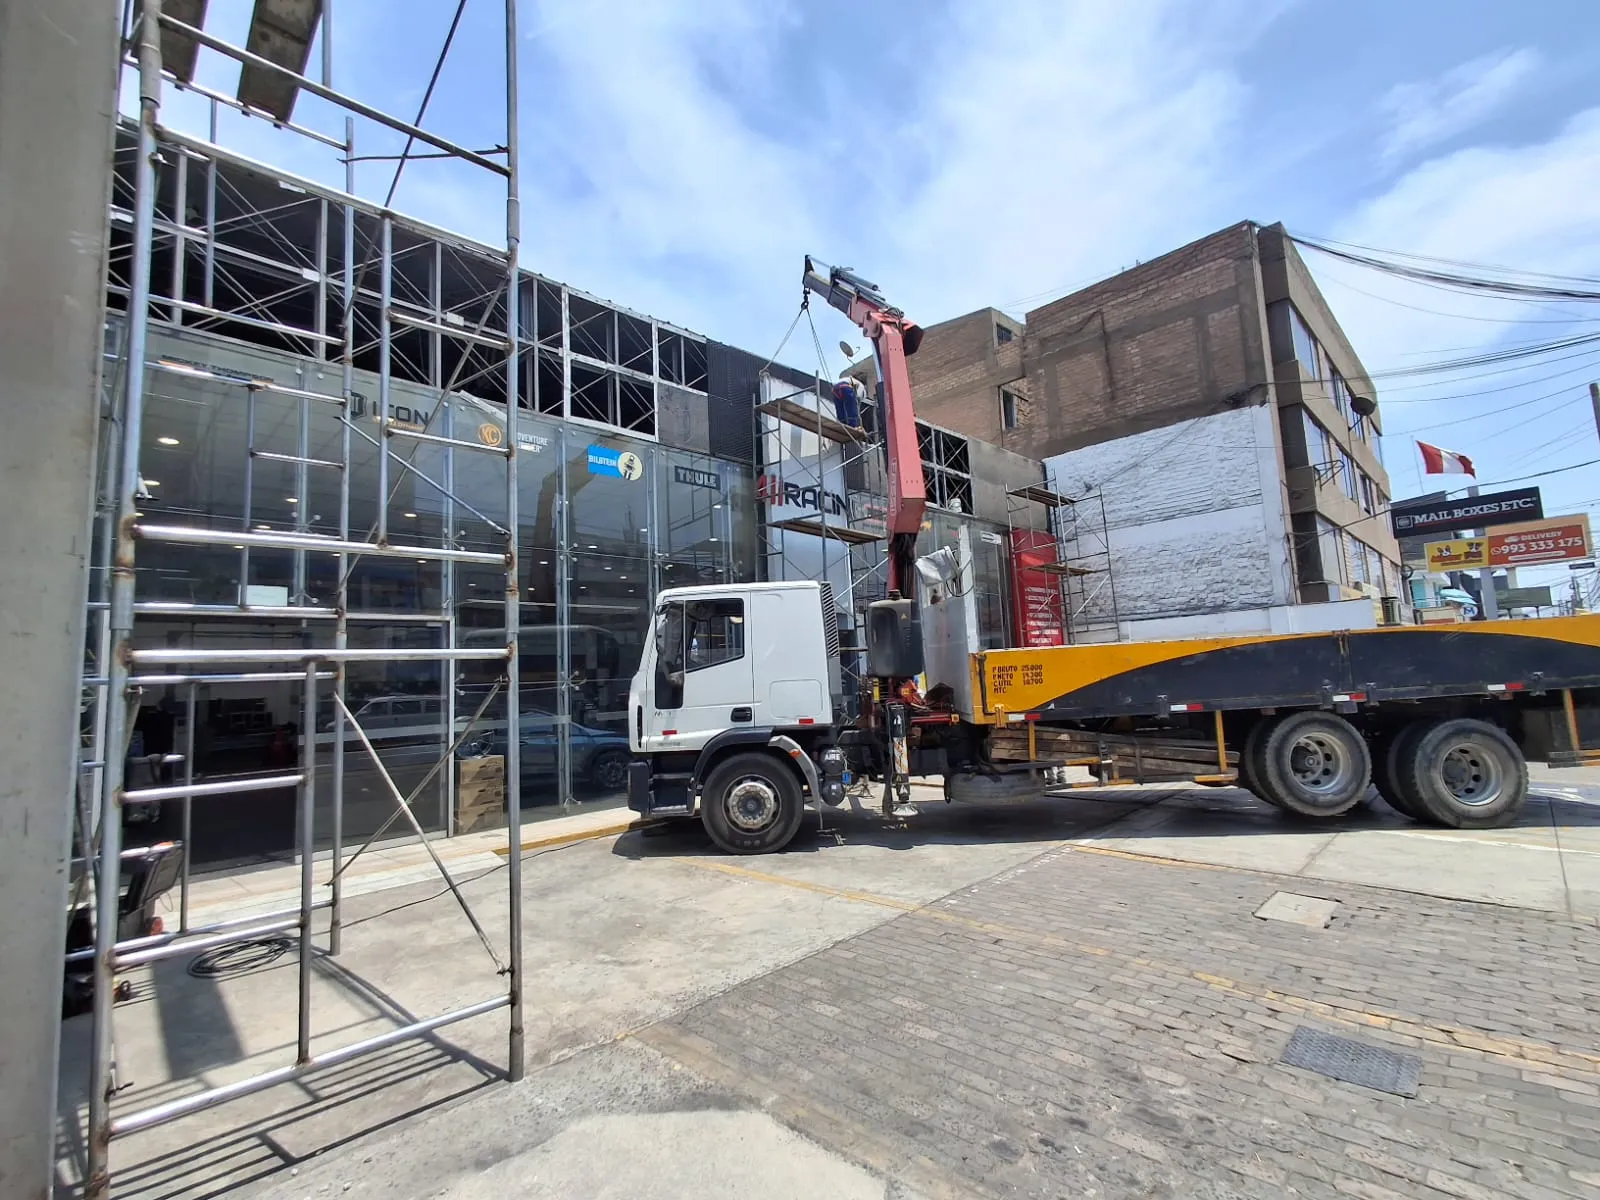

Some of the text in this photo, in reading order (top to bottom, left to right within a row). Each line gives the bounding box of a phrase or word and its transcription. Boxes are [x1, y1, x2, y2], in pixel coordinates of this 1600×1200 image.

[677, 468, 717, 487] THULE
[1414, 510, 1452, 524] MAIL
[1453, 503, 1500, 518] BOXES
[1501, 536, 1583, 554] 993 333 175
[1520, 531, 1562, 541] DELIVERY
[824, 753, 841, 761] AIRE
